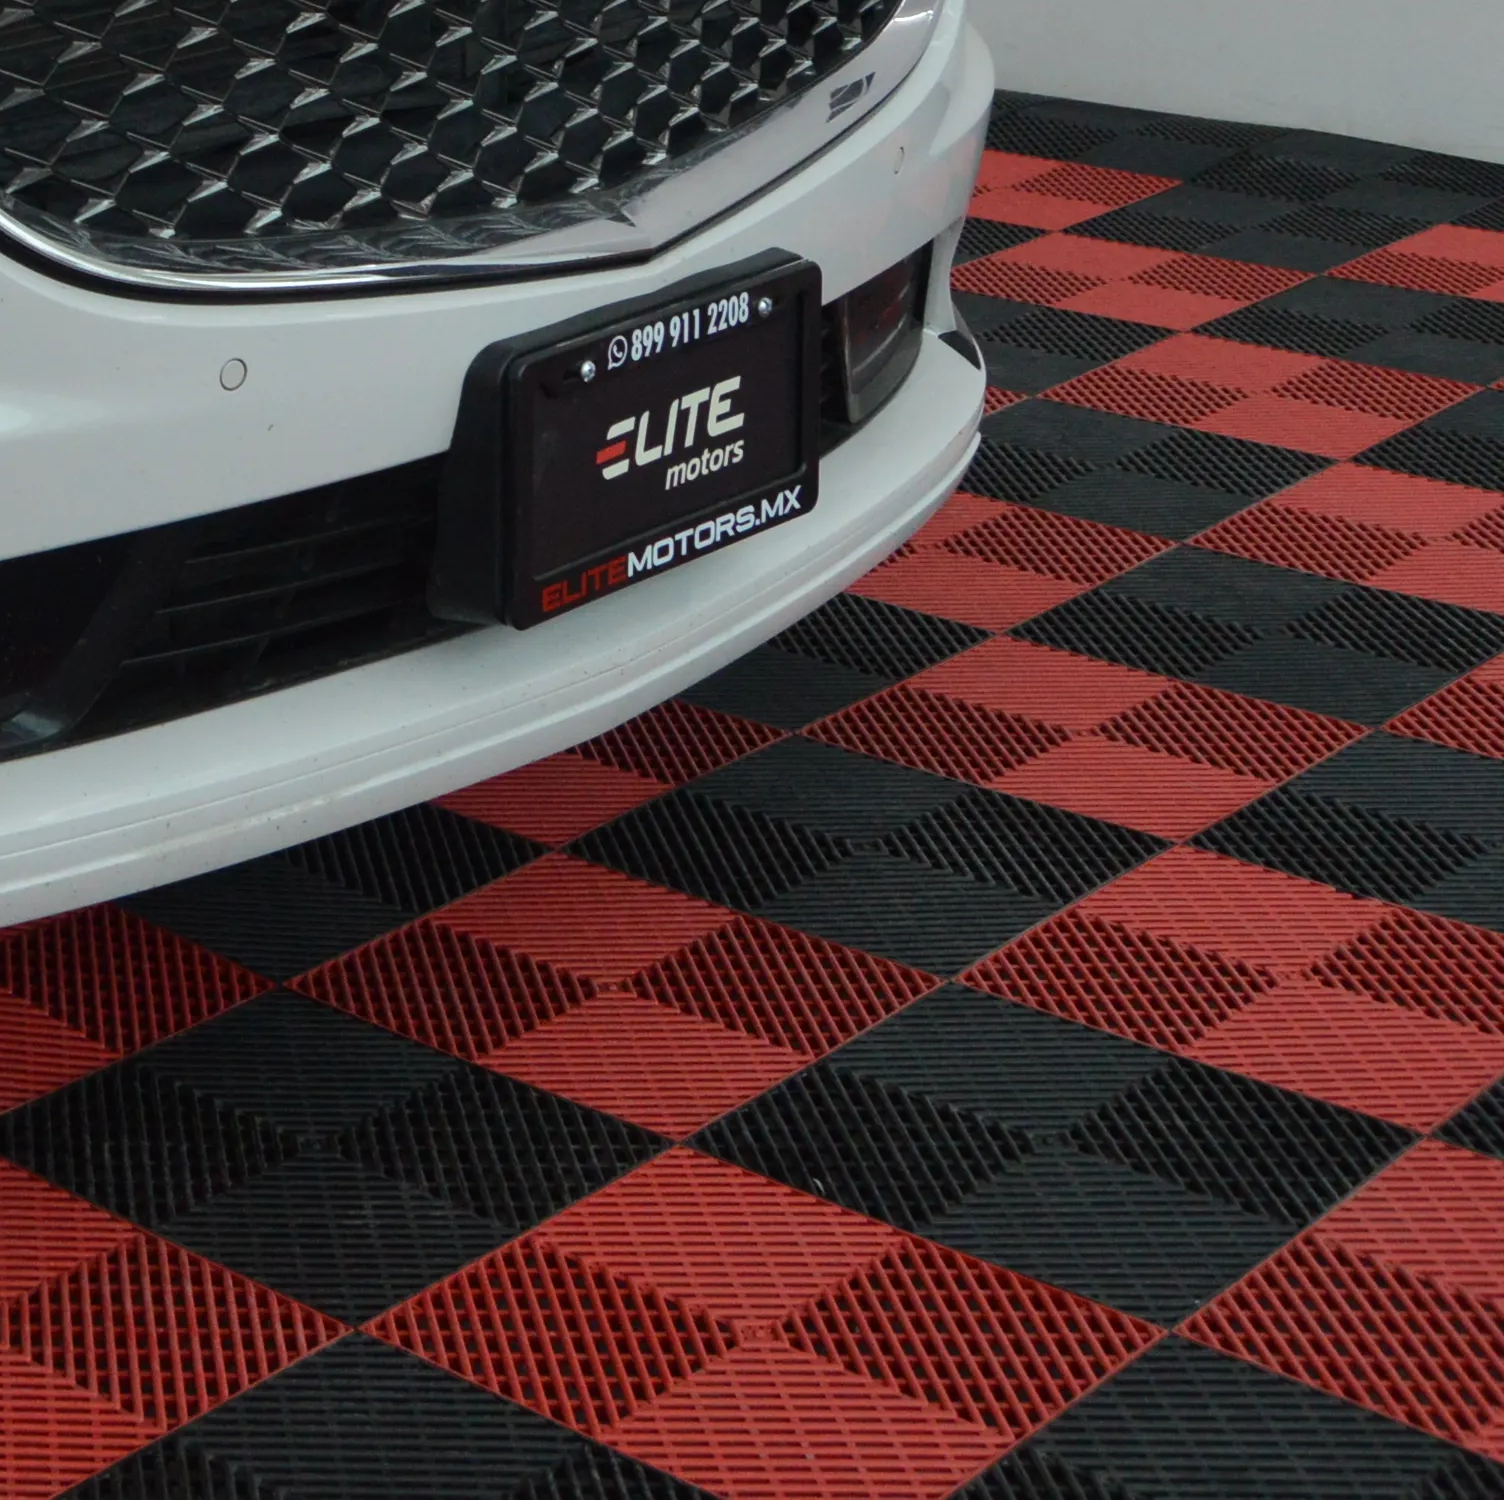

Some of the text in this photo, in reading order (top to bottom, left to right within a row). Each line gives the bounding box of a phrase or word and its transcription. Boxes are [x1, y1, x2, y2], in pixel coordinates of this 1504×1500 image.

[630, 291, 750, 362] 899 911 2208
[596, 375, 745, 480] ELITE
[665, 439, 745, 490] motors
[541, 485, 802, 612] ELITEMOTORS.MX
